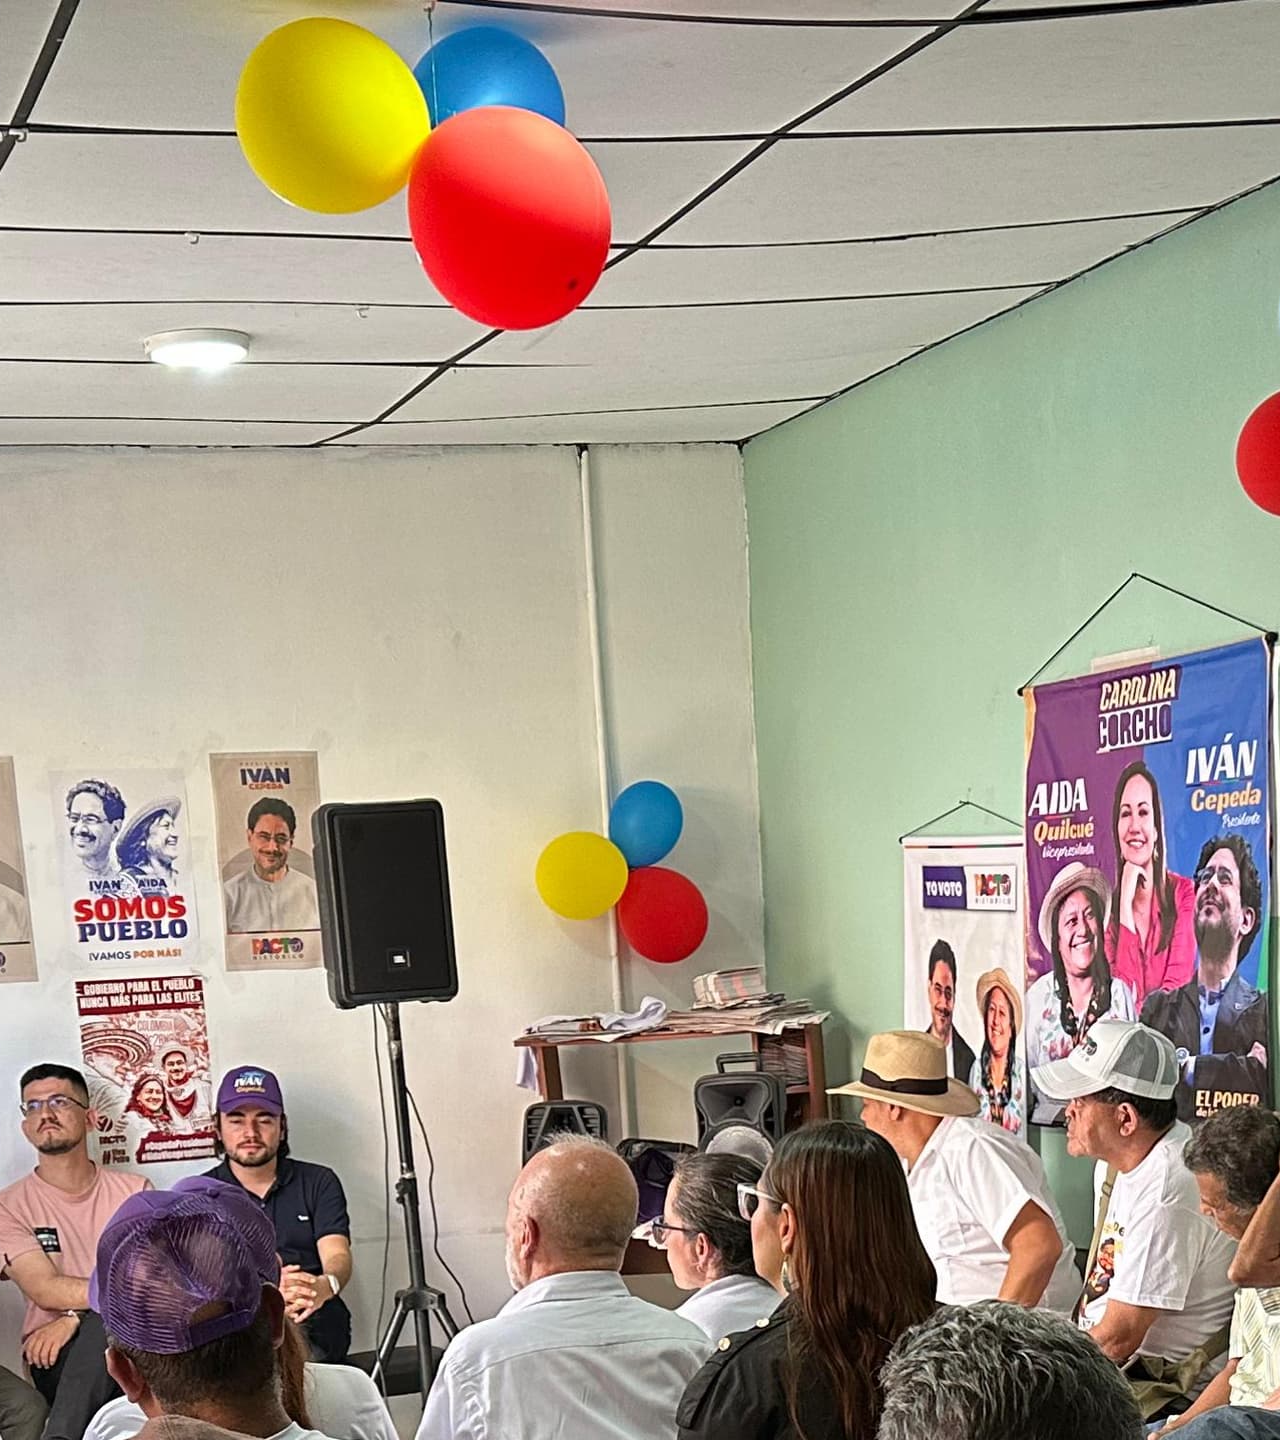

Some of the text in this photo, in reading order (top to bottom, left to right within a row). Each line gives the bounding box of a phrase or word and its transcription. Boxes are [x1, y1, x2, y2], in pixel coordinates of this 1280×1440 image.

[1100, 668, 1177, 711] CAROLINA
[1098, 703, 1172, 747] CORCHO
[1186, 733, 1258, 784] IVÁN
[1028, 778, 1088, 817] AIDA
[1191, 783, 1262, 815] Cepeda
[1034, 815, 1094, 846] Quilcué
[926, 881, 962, 896] YO VOTO
[974, 873, 1011, 896] PACTO
[74, 895, 186, 922] SOMOS
[77, 919, 188, 942] PUEBLO
[133, 949, 155, 959] POR
[252, 937, 303, 954] PACTO
[83, 979, 195, 995] GOBIERNO PARA EL PUEBLO
[80, 997, 109, 1009] NUNCA
[110, 993, 131, 1006] MÁS
[132, 994, 155, 1005] PARA
[157, 993, 172, 1003] LAS
[1196, 1090, 1260, 1107] EL PODER
